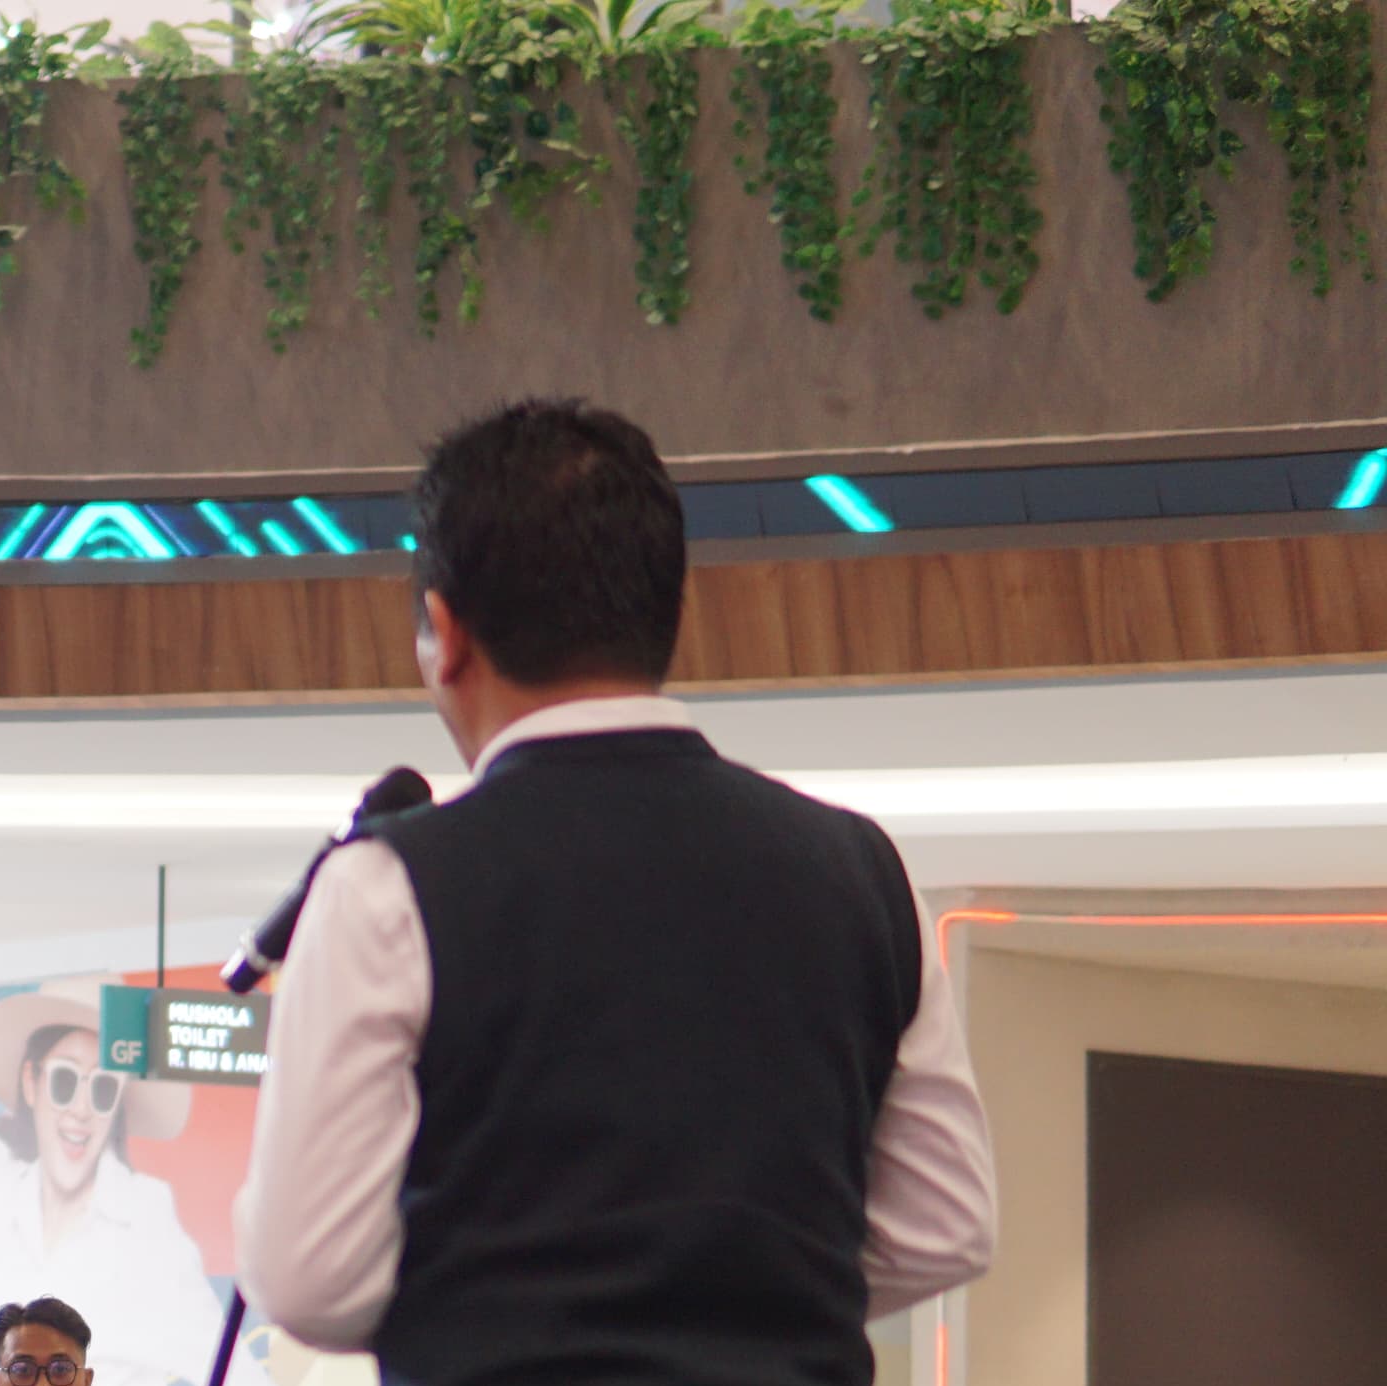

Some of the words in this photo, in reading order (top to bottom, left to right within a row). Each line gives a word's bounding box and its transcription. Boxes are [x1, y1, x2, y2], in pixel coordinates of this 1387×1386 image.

[168, 1002, 253, 1027] MUSHOLA
[168, 1025, 230, 1048] TOILET
[110, 1040, 143, 1065] GF
[188, 1050, 218, 1071] IBU
[235, 1053, 273, 1073] ANA
